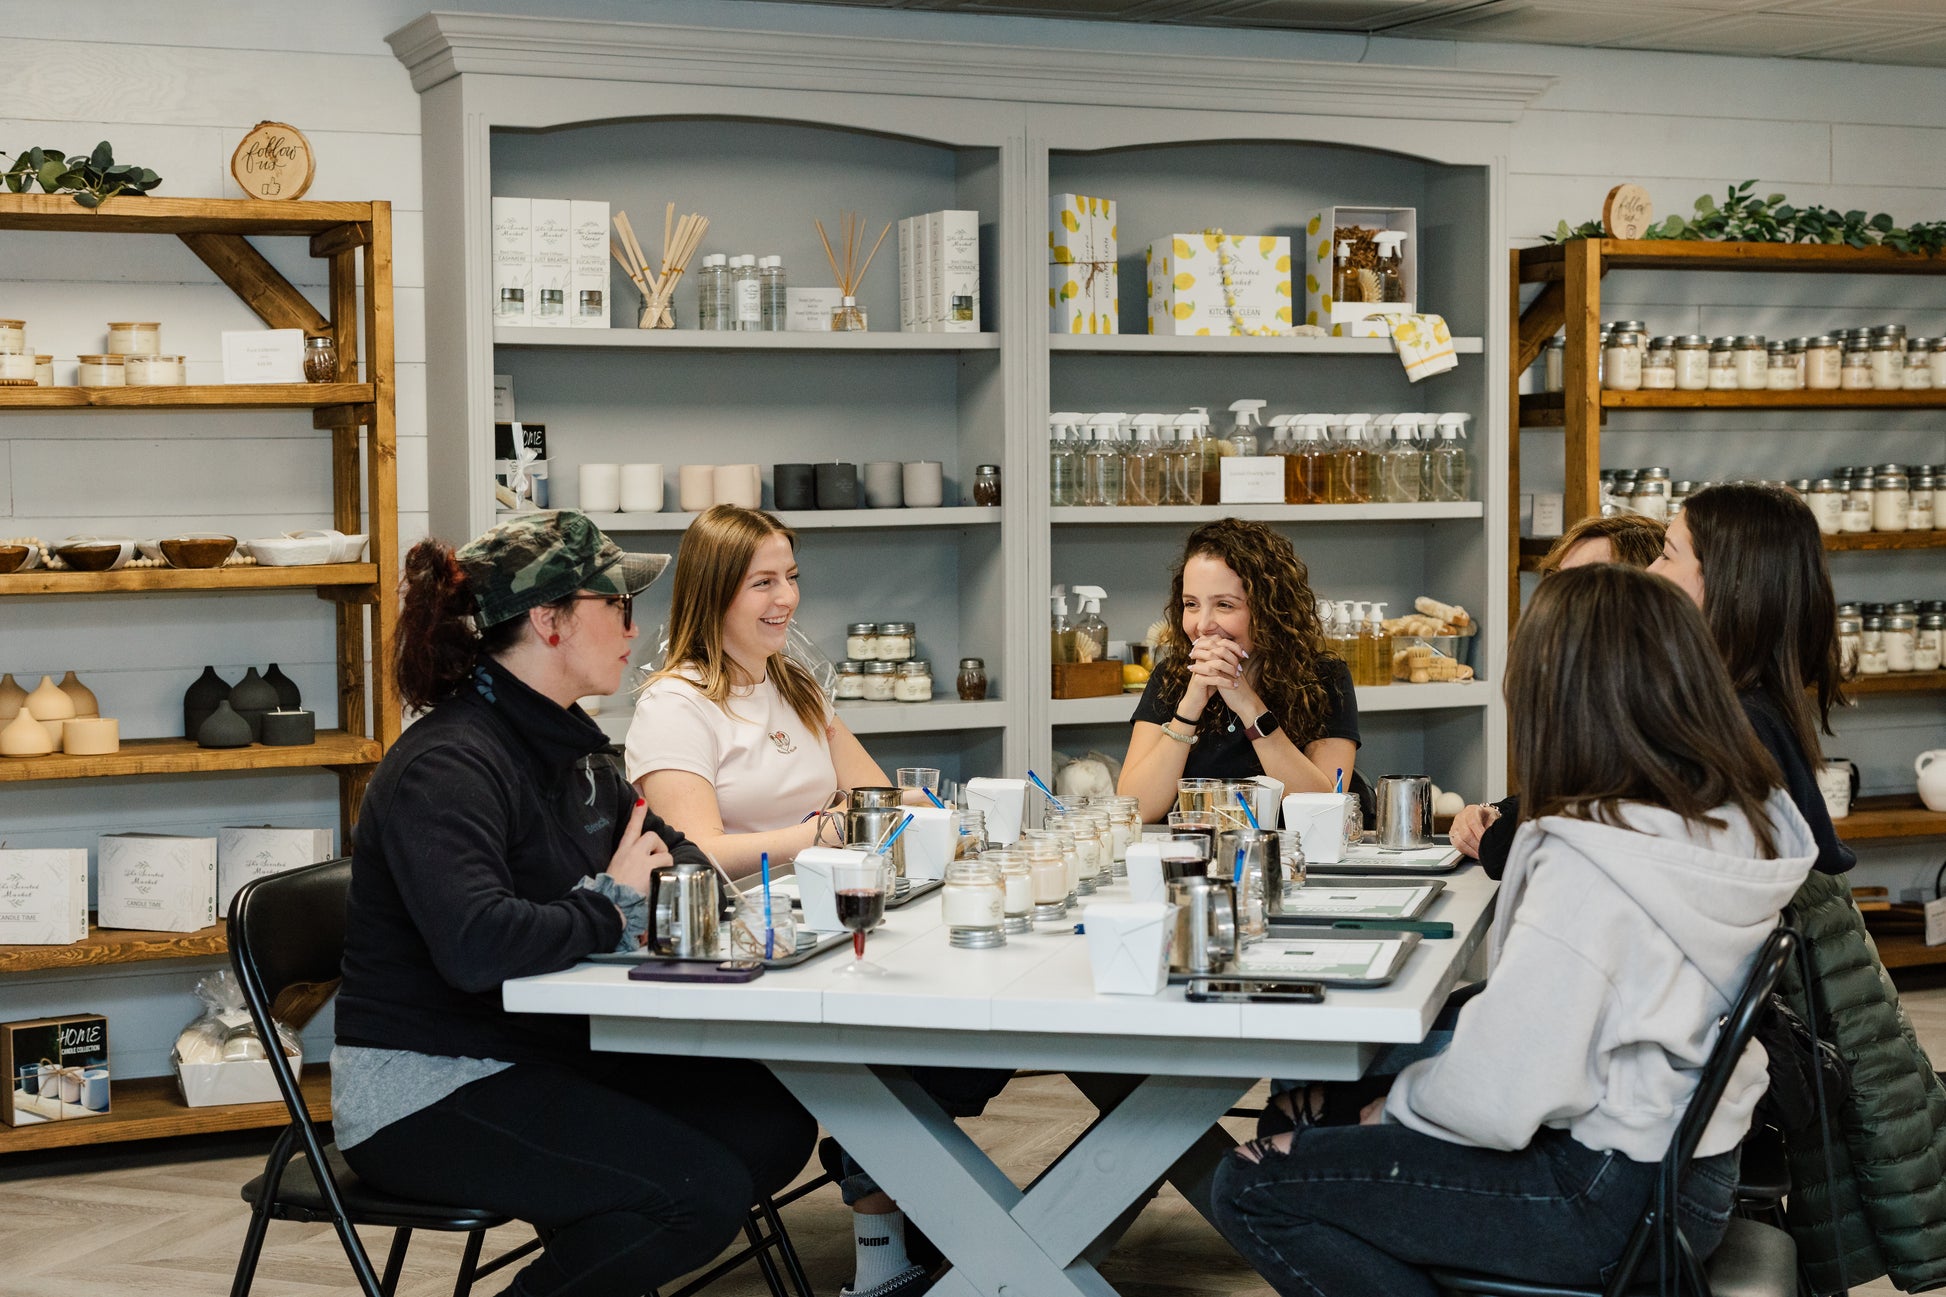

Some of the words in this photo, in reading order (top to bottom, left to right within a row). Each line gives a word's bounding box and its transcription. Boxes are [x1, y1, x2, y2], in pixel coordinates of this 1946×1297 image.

[241, 135, 304, 174] follow
[256, 160, 288, 171] us
[1239, 308, 1261, 316] CLEAN
[523, 430, 543, 447] OME
[127, 899, 147, 907] CANDLE
[57, 1025, 101, 1047] HOME
[858, 1236, 890, 1247] PUMA
